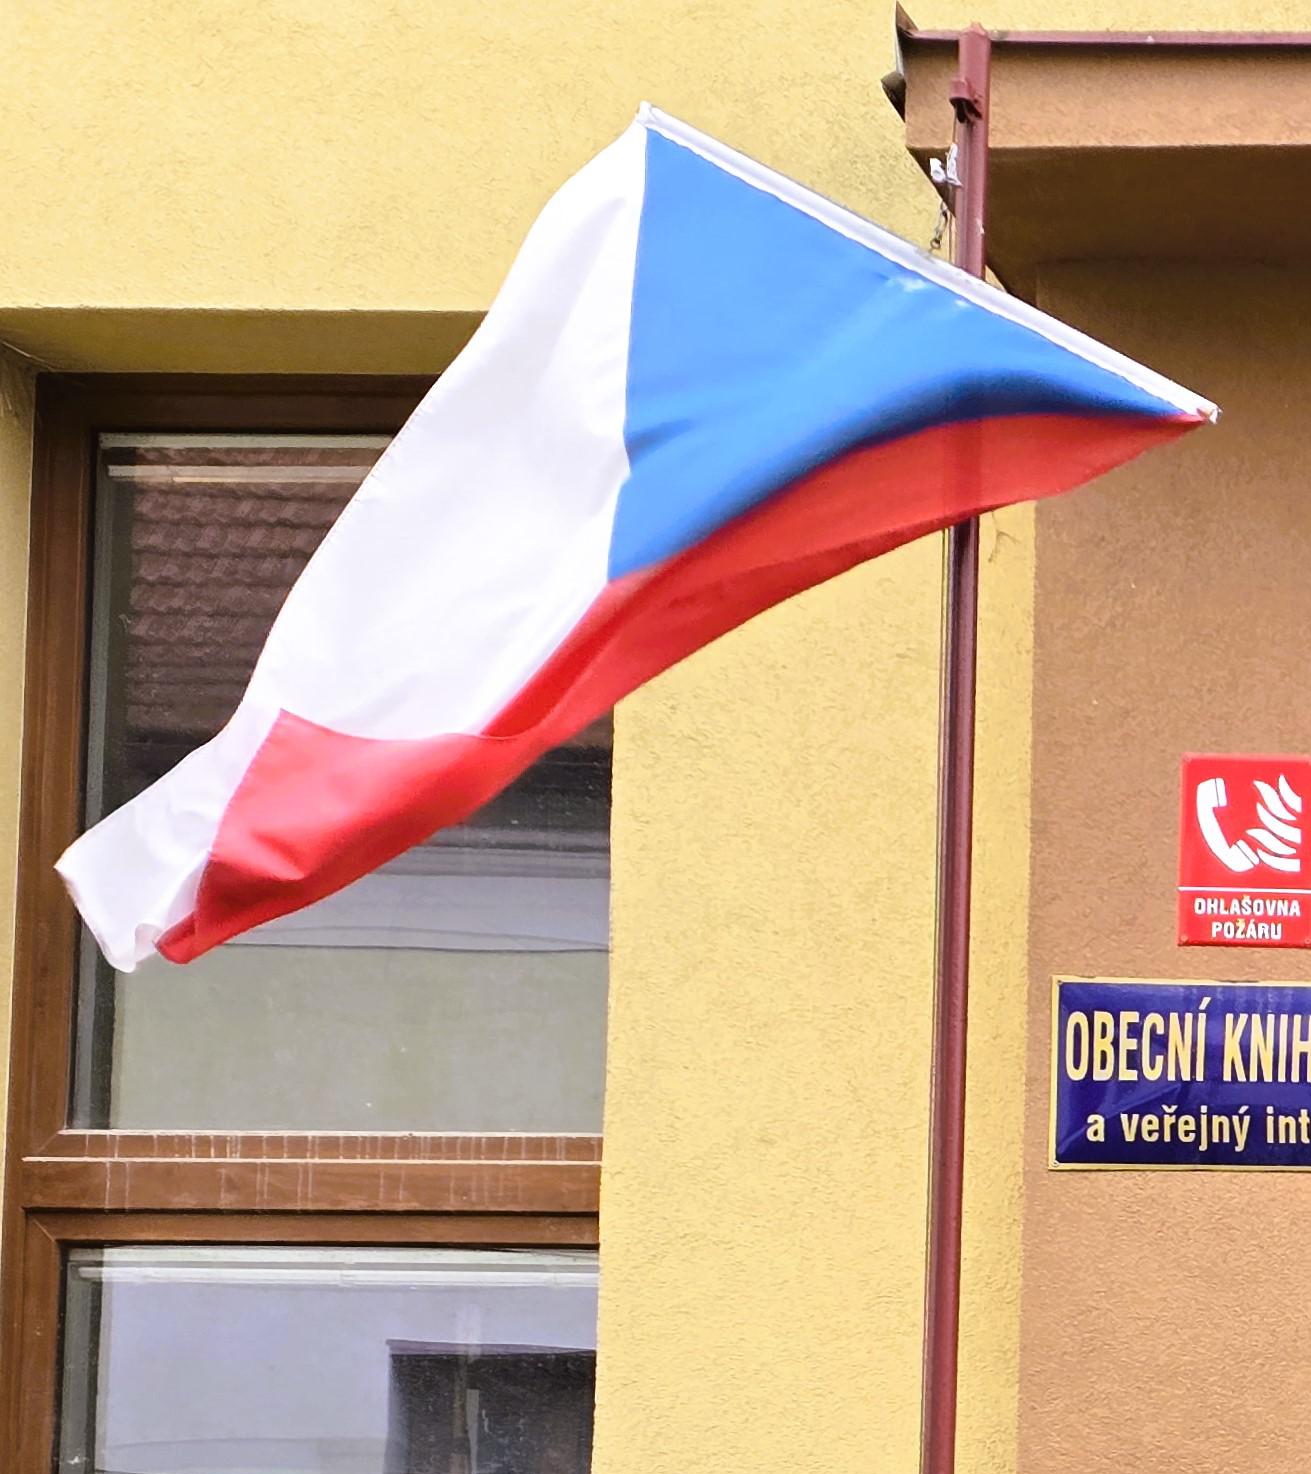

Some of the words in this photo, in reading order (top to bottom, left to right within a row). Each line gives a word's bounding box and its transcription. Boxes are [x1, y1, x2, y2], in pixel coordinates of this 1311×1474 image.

[1194, 894, 1301, 917] OHLAŠOVNA
[1211, 918, 1282, 941] POŽÁRU
[1065, 996, 1211, 1082] OBECNÍ
[1086, 1112, 1105, 1142] a
[1120, 1104, 1250, 1152] veřejný
